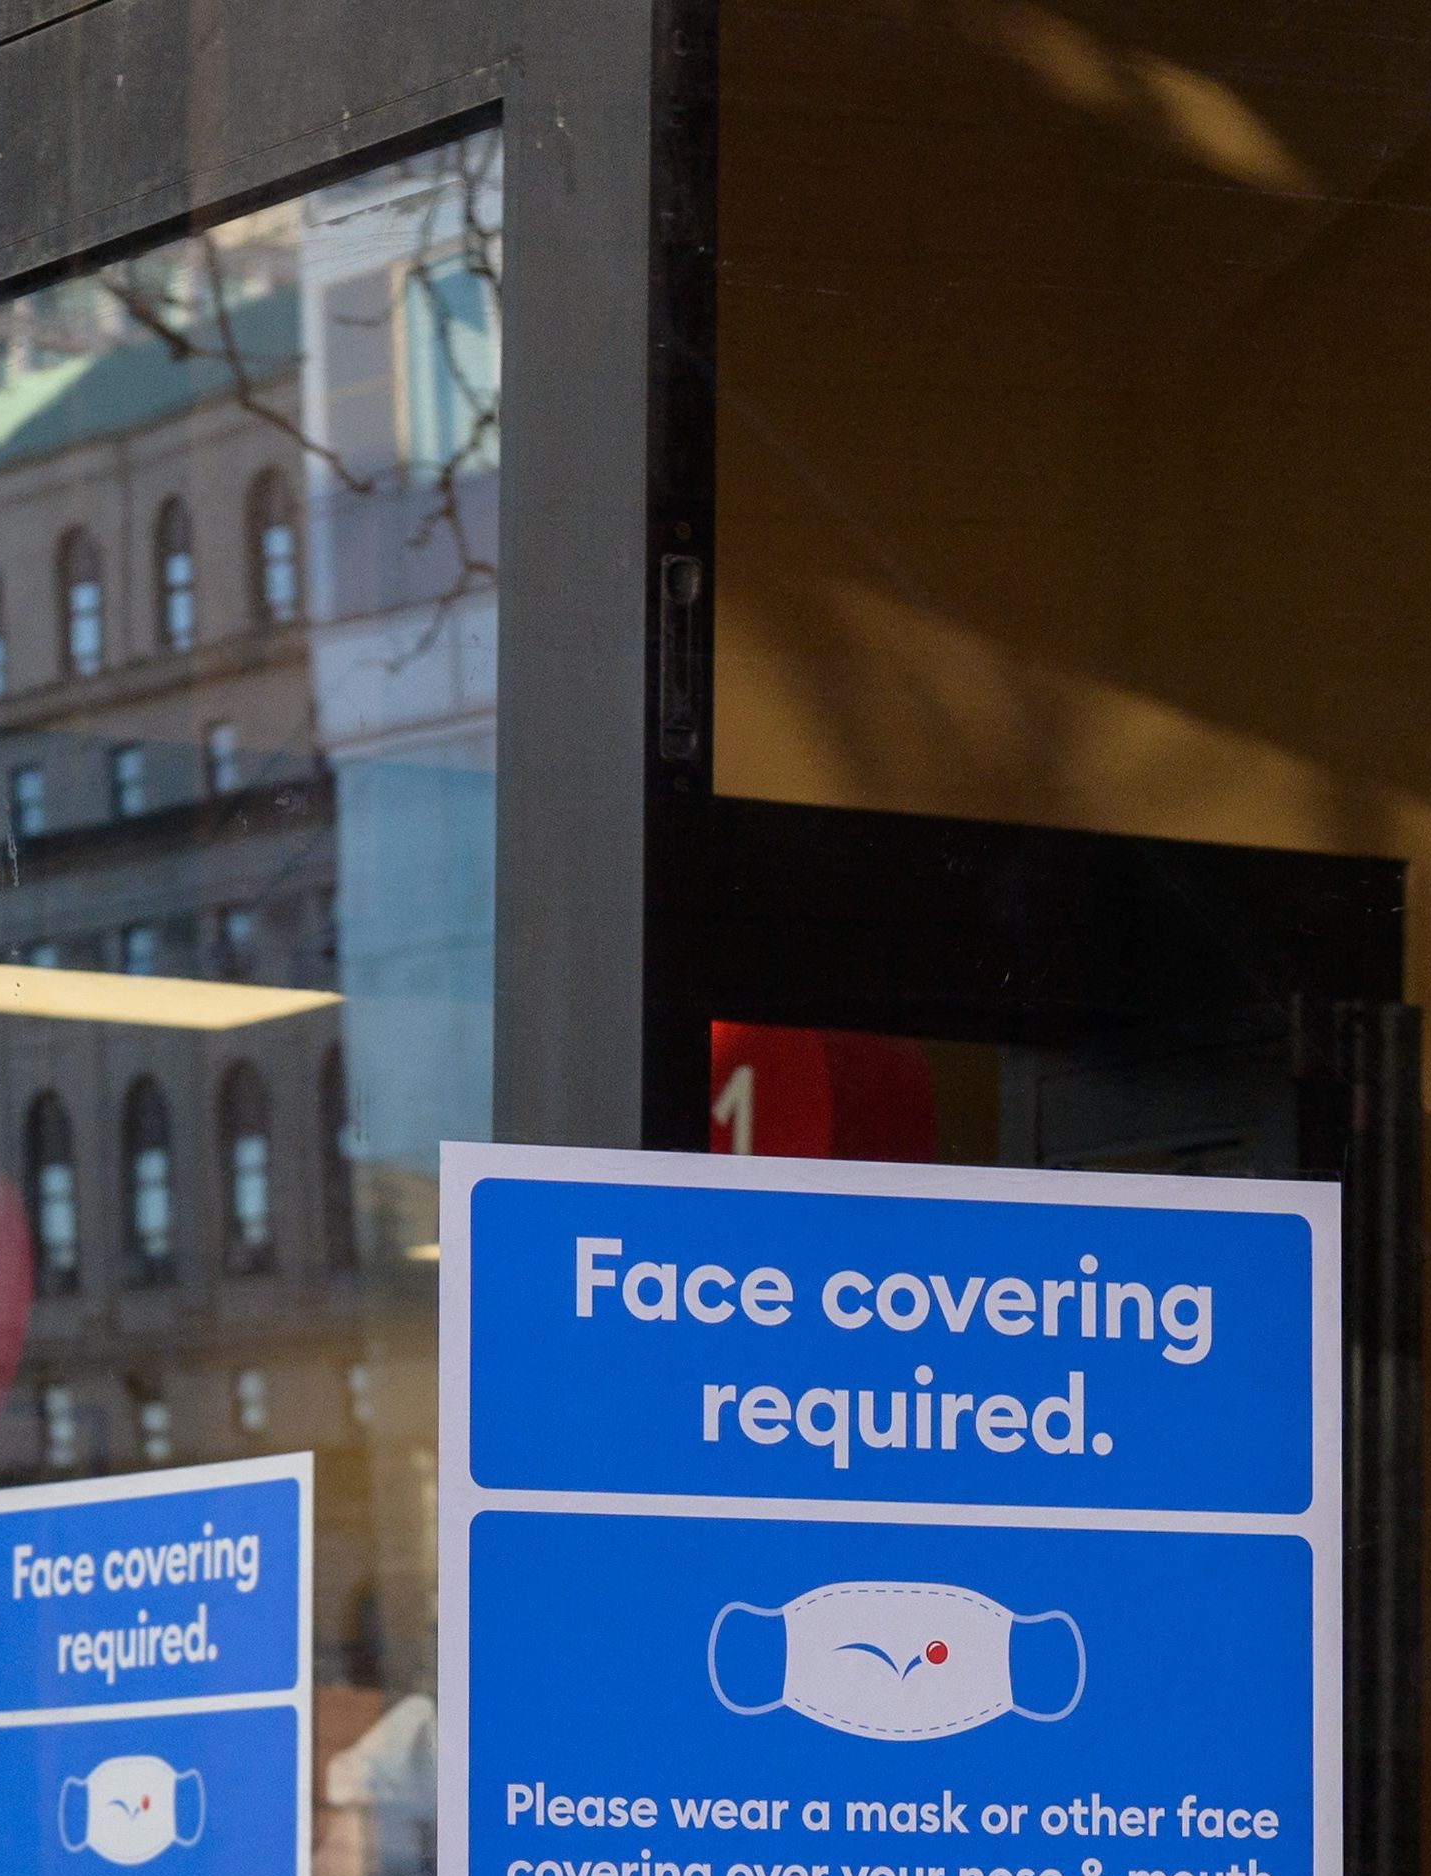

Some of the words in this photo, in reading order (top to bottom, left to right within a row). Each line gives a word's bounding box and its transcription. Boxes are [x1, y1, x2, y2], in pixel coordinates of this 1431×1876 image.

[576, 1237, 793, 1326] Face
[822, 1254, 1212, 1364] covering
[703, 1365, 1113, 1469] required.
[14, 1545, 95, 1599] Face
[103, 1522, 259, 1593] covering
[58, 1603, 218, 1684] required.
[507, 1782, 657, 1828] Please
[671, 1799, 789, 1830] wear
[802, 1801, 829, 1831] a
[847, 1790, 969, 1833] mask
[981, 1804, 1028, 1834] or
[1041, 1793, 1165, 1836] other
[1177, 1795, 1279, 1839] face
